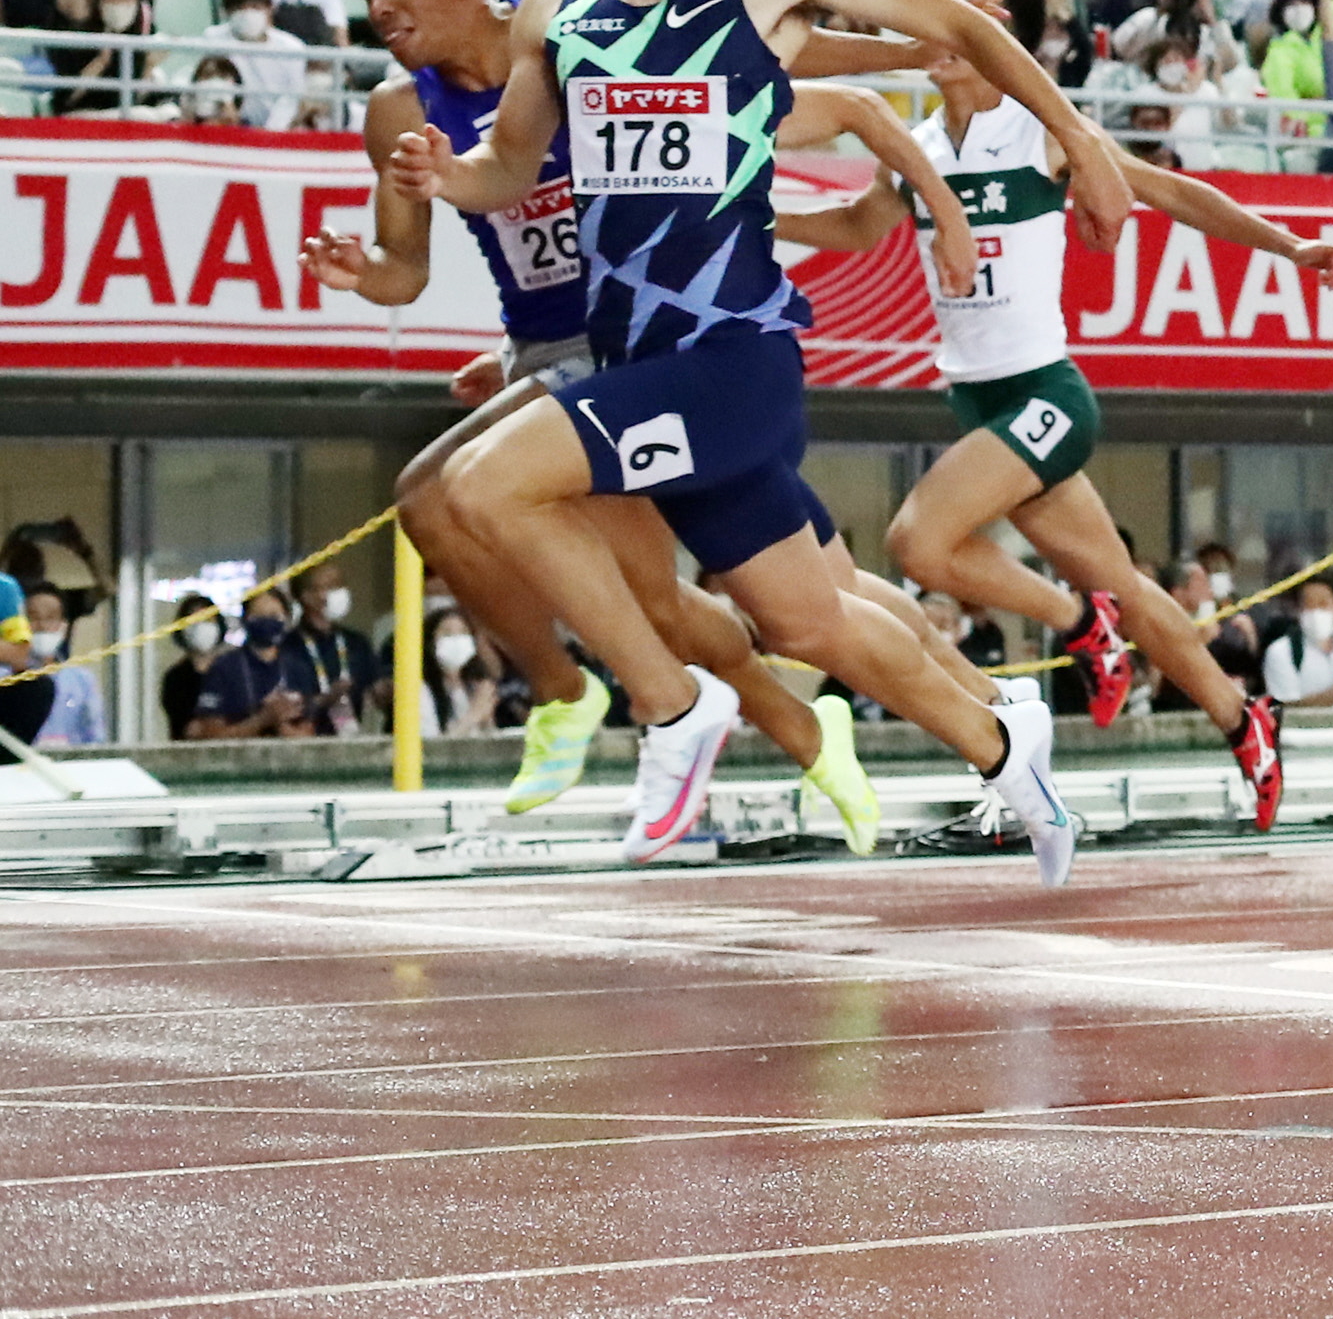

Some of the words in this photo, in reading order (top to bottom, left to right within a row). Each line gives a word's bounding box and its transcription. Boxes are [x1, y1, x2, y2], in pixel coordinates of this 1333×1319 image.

[610, 88, 704, 109] ヤマザキ
[596, 120, 691, 172] 178
[0, 175, 372, 311] JAAF
